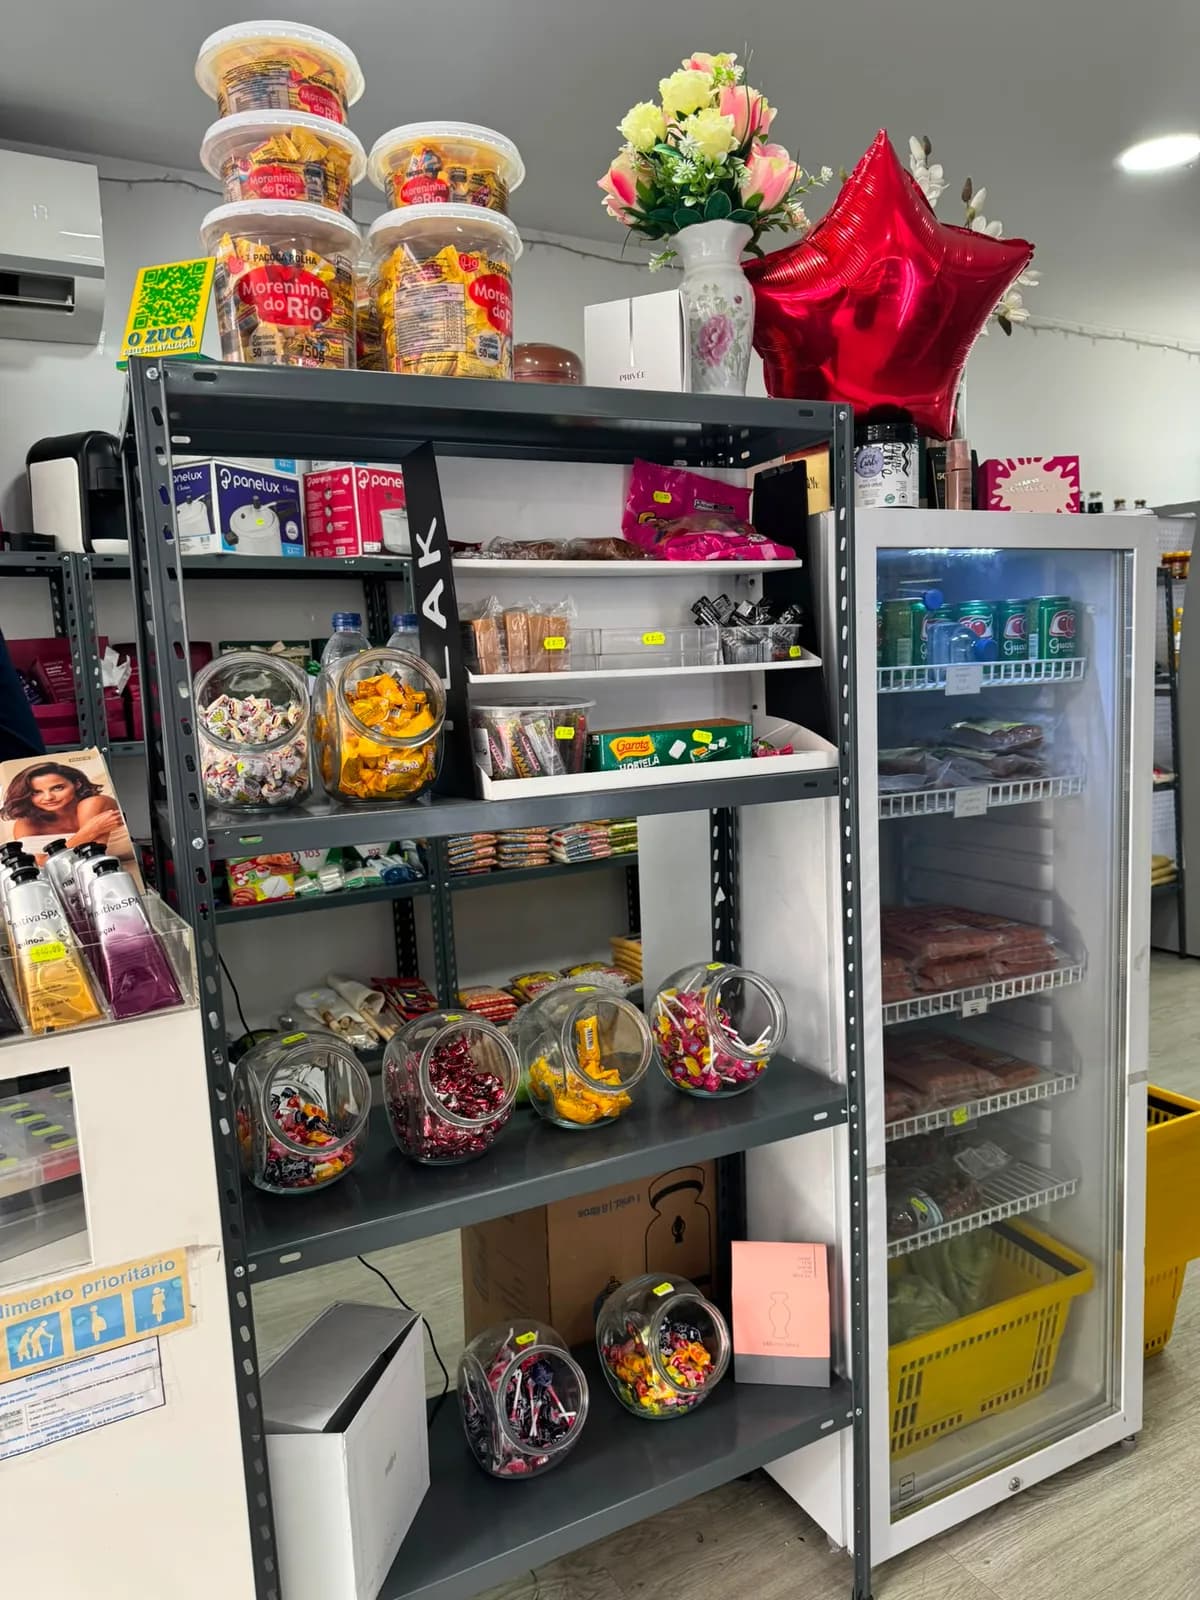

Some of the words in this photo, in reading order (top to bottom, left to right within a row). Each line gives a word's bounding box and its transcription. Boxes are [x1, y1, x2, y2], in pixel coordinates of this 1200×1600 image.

[250, 172, 300, 185] Moreninha
[262, 184, 275, 194] do
[275, 183, 297, 197] Rio
[242, 278, 330, 300] Moreninha
[474, 283, 512, 305] Moren
[263, 297, 286, 312] do
[286, 296, 323, 322] Rio
[492, 306, 506, 318] do
[128, 331, 141, 347] O
[145, 324, 194, 345] ZUCA
[298, 343, 325, 364] 750g
[173, 470, 203, 484] nelux
[233, 474, 281, 494] panelux
[371, 474, 403, 488] pane
[303, 849, 321, 859] 103
[81, 1259, 176, 1299] prioritário
